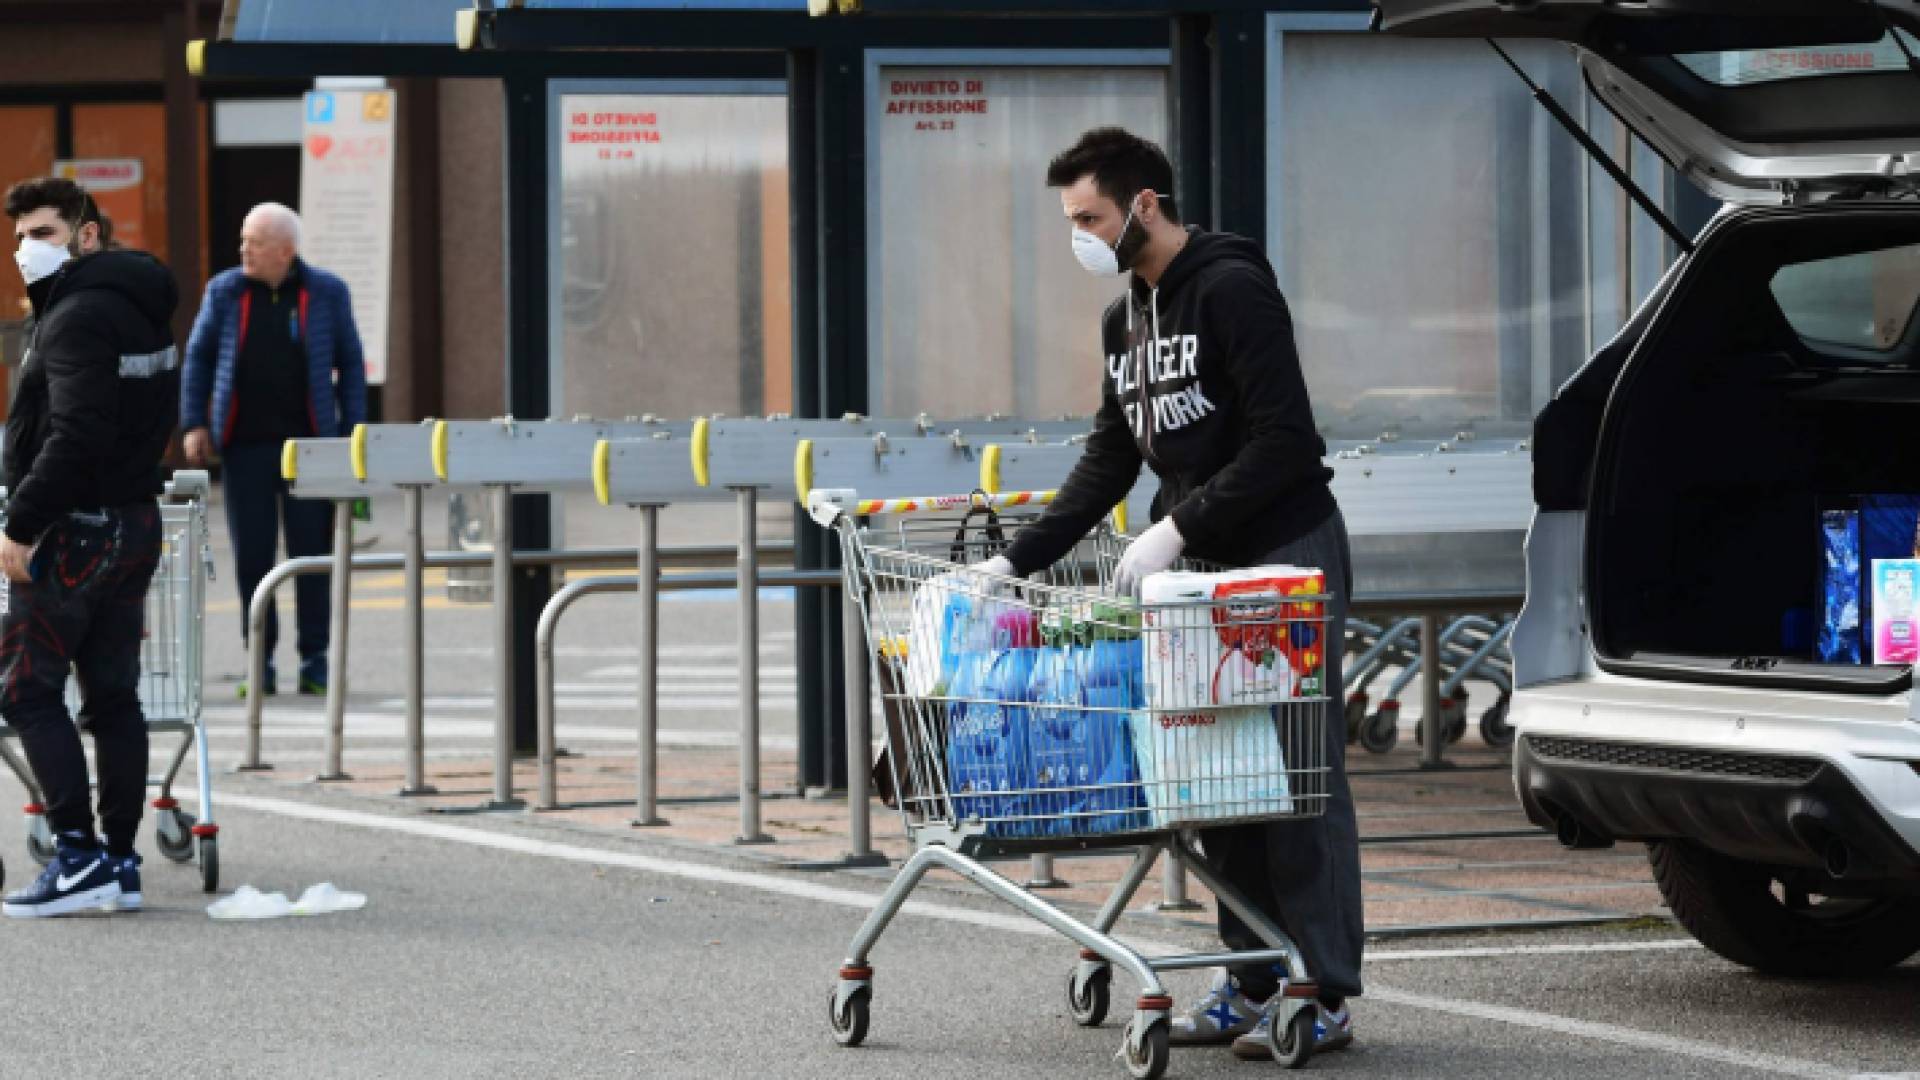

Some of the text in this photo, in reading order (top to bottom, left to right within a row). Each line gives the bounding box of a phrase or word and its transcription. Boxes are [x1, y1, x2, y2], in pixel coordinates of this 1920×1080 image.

[891, 81, 983, 95] DIVIETO DI
[886, 99, 987, 114] AFFISSIONE
